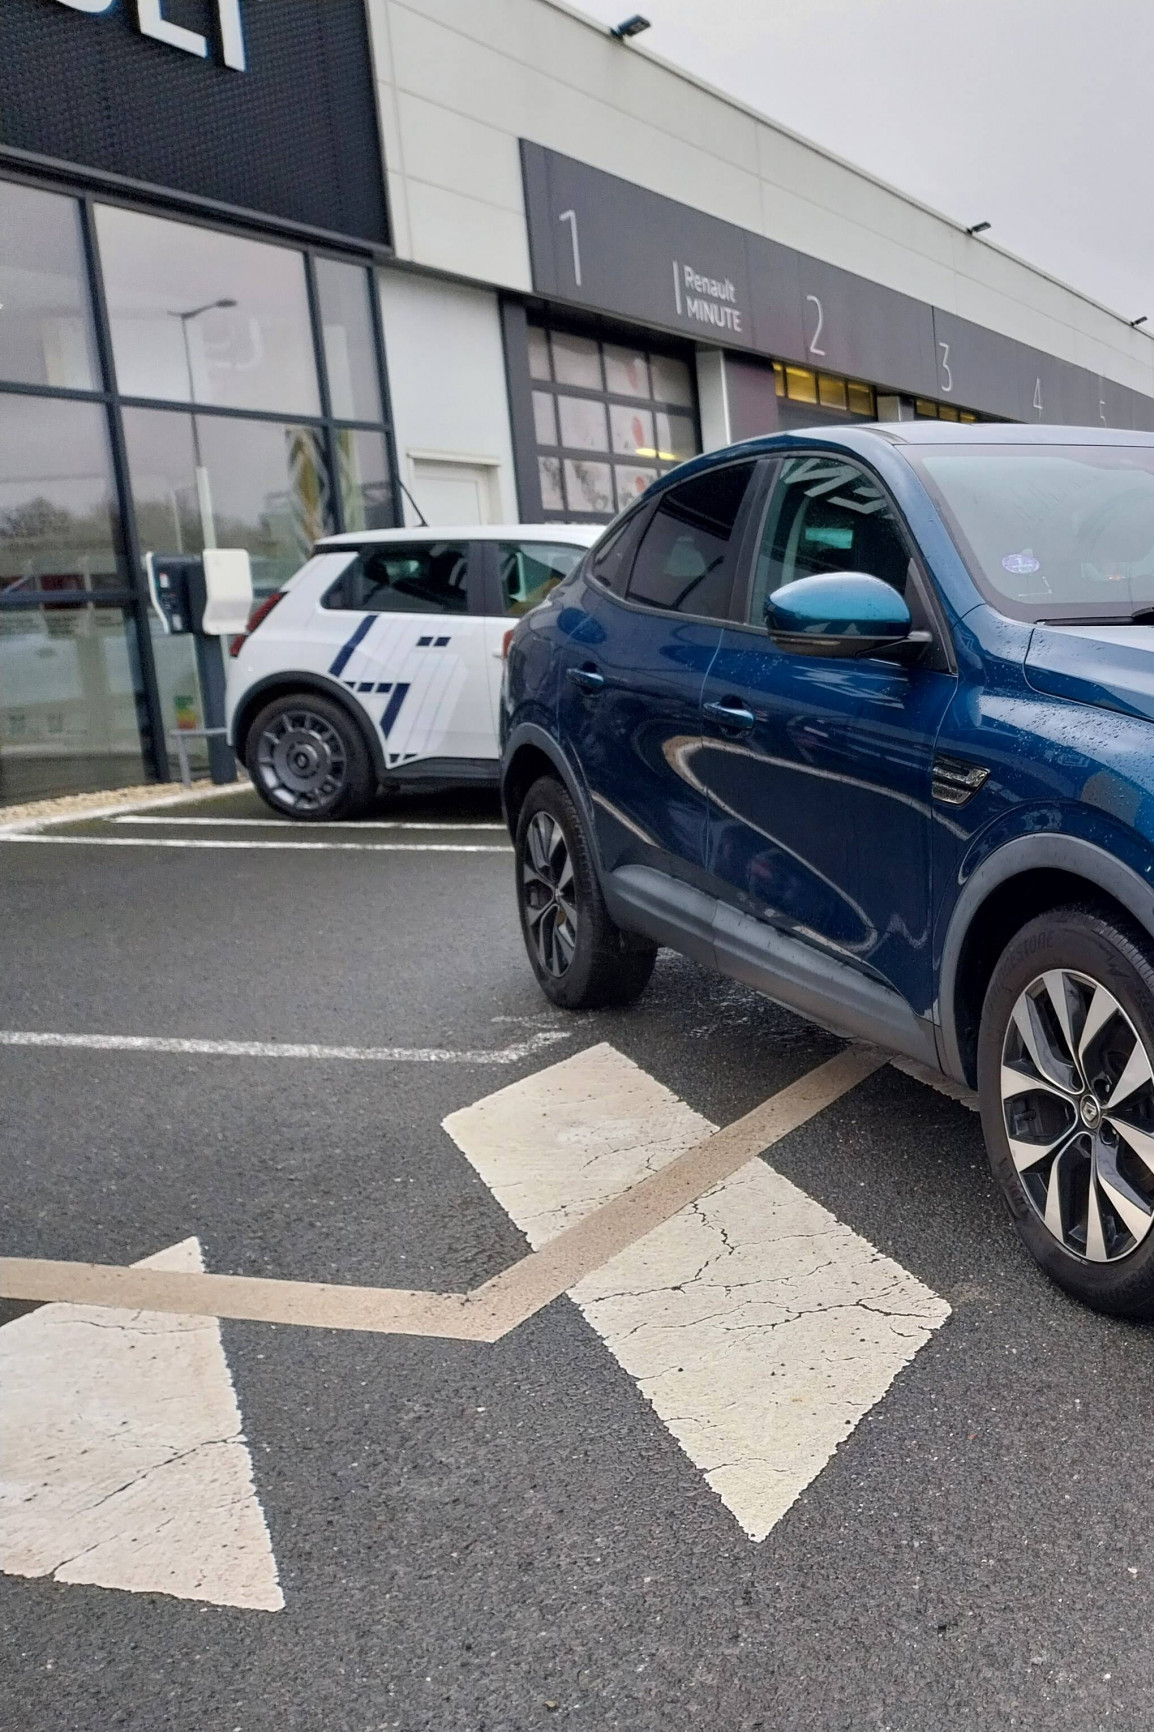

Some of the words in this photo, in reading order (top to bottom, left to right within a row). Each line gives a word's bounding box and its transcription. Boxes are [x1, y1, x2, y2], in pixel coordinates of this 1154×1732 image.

[559, 209, 582, 286] 1
[683, 264, 737, 303] Renault
[685, 295, 742, 333] MINUTE
[806, 295, 826, 357] 2
[939, 342, 953, 392] 3
[1033, 377, 1043, 417] 4
